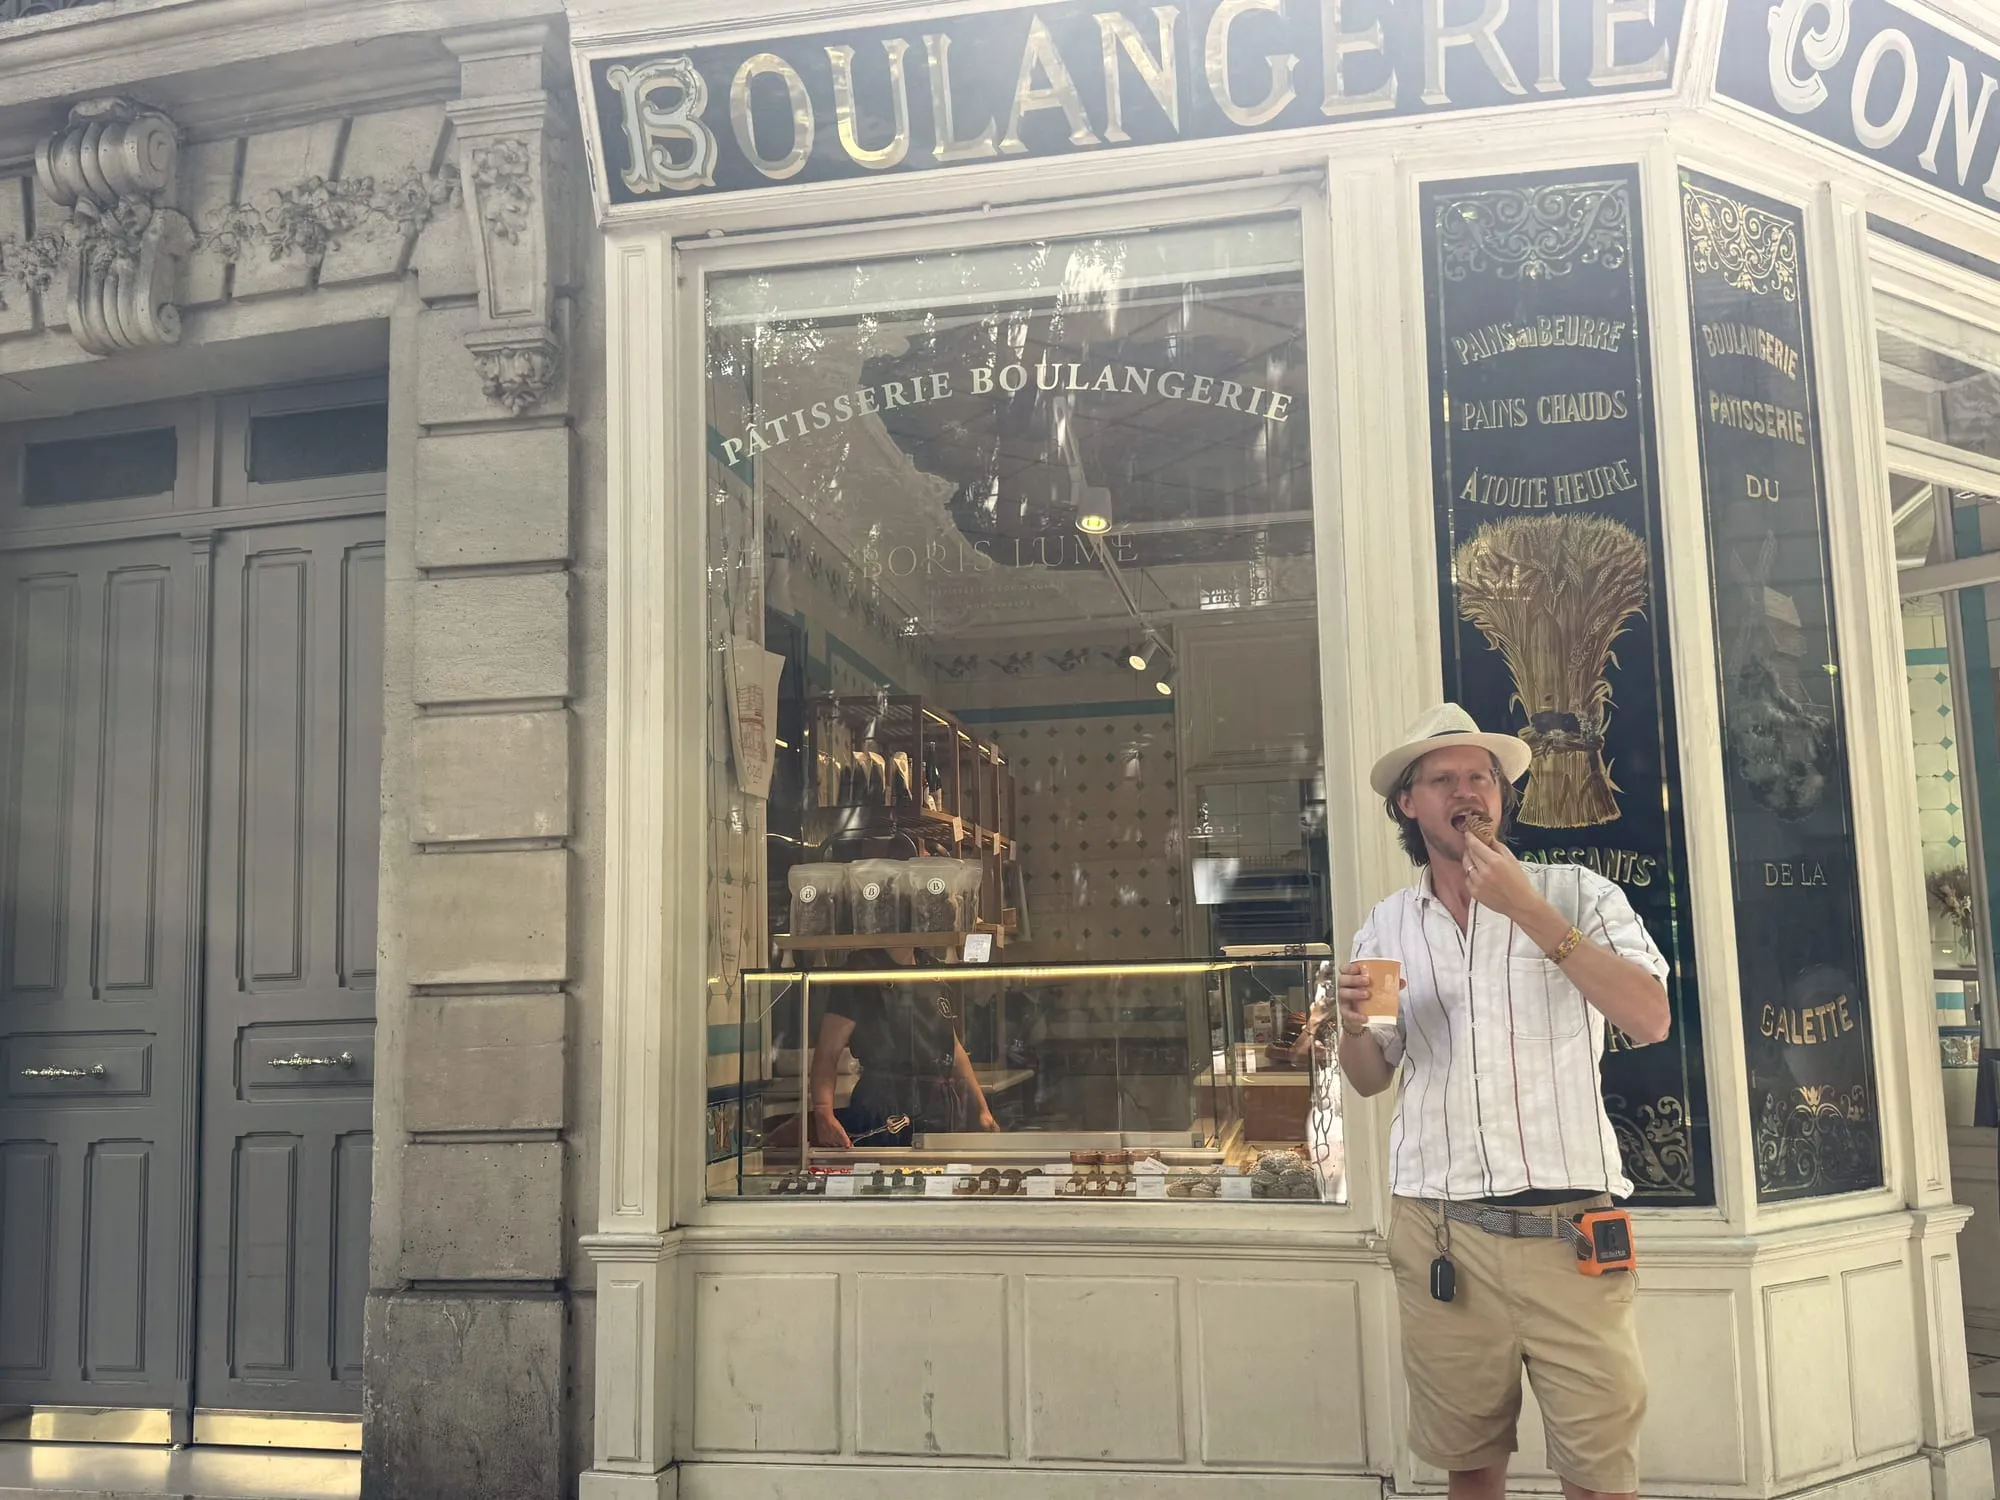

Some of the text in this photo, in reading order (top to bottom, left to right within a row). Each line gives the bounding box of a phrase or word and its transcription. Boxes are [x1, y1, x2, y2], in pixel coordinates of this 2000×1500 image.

[606, 0, 1670, 193] BOULANGERIE
[1768, 0, 2000, 202] CON
[1451, 314, 1626, 366] PAINS au BEURRE
[1701, 322, 1799, 381] BOULANGERIE
[720, 363, 1292, 467] PÂTISSERIE BOULANGERIE
[1461, 389, 1628, 431] PAINS CHAUDS
[1709, 389, 1806, 445] PATISSERIE
[1481, 473, 1548, 508] TOUTE
[1552, 458, 1638, 506] HEURE
[1745, 474, 1780, 503] DU
[863, 540, 993, 578] BORIS
[1764, 862, 1828, 887] DE LA
[1760, 995, 1855, 1046] GALETTE
